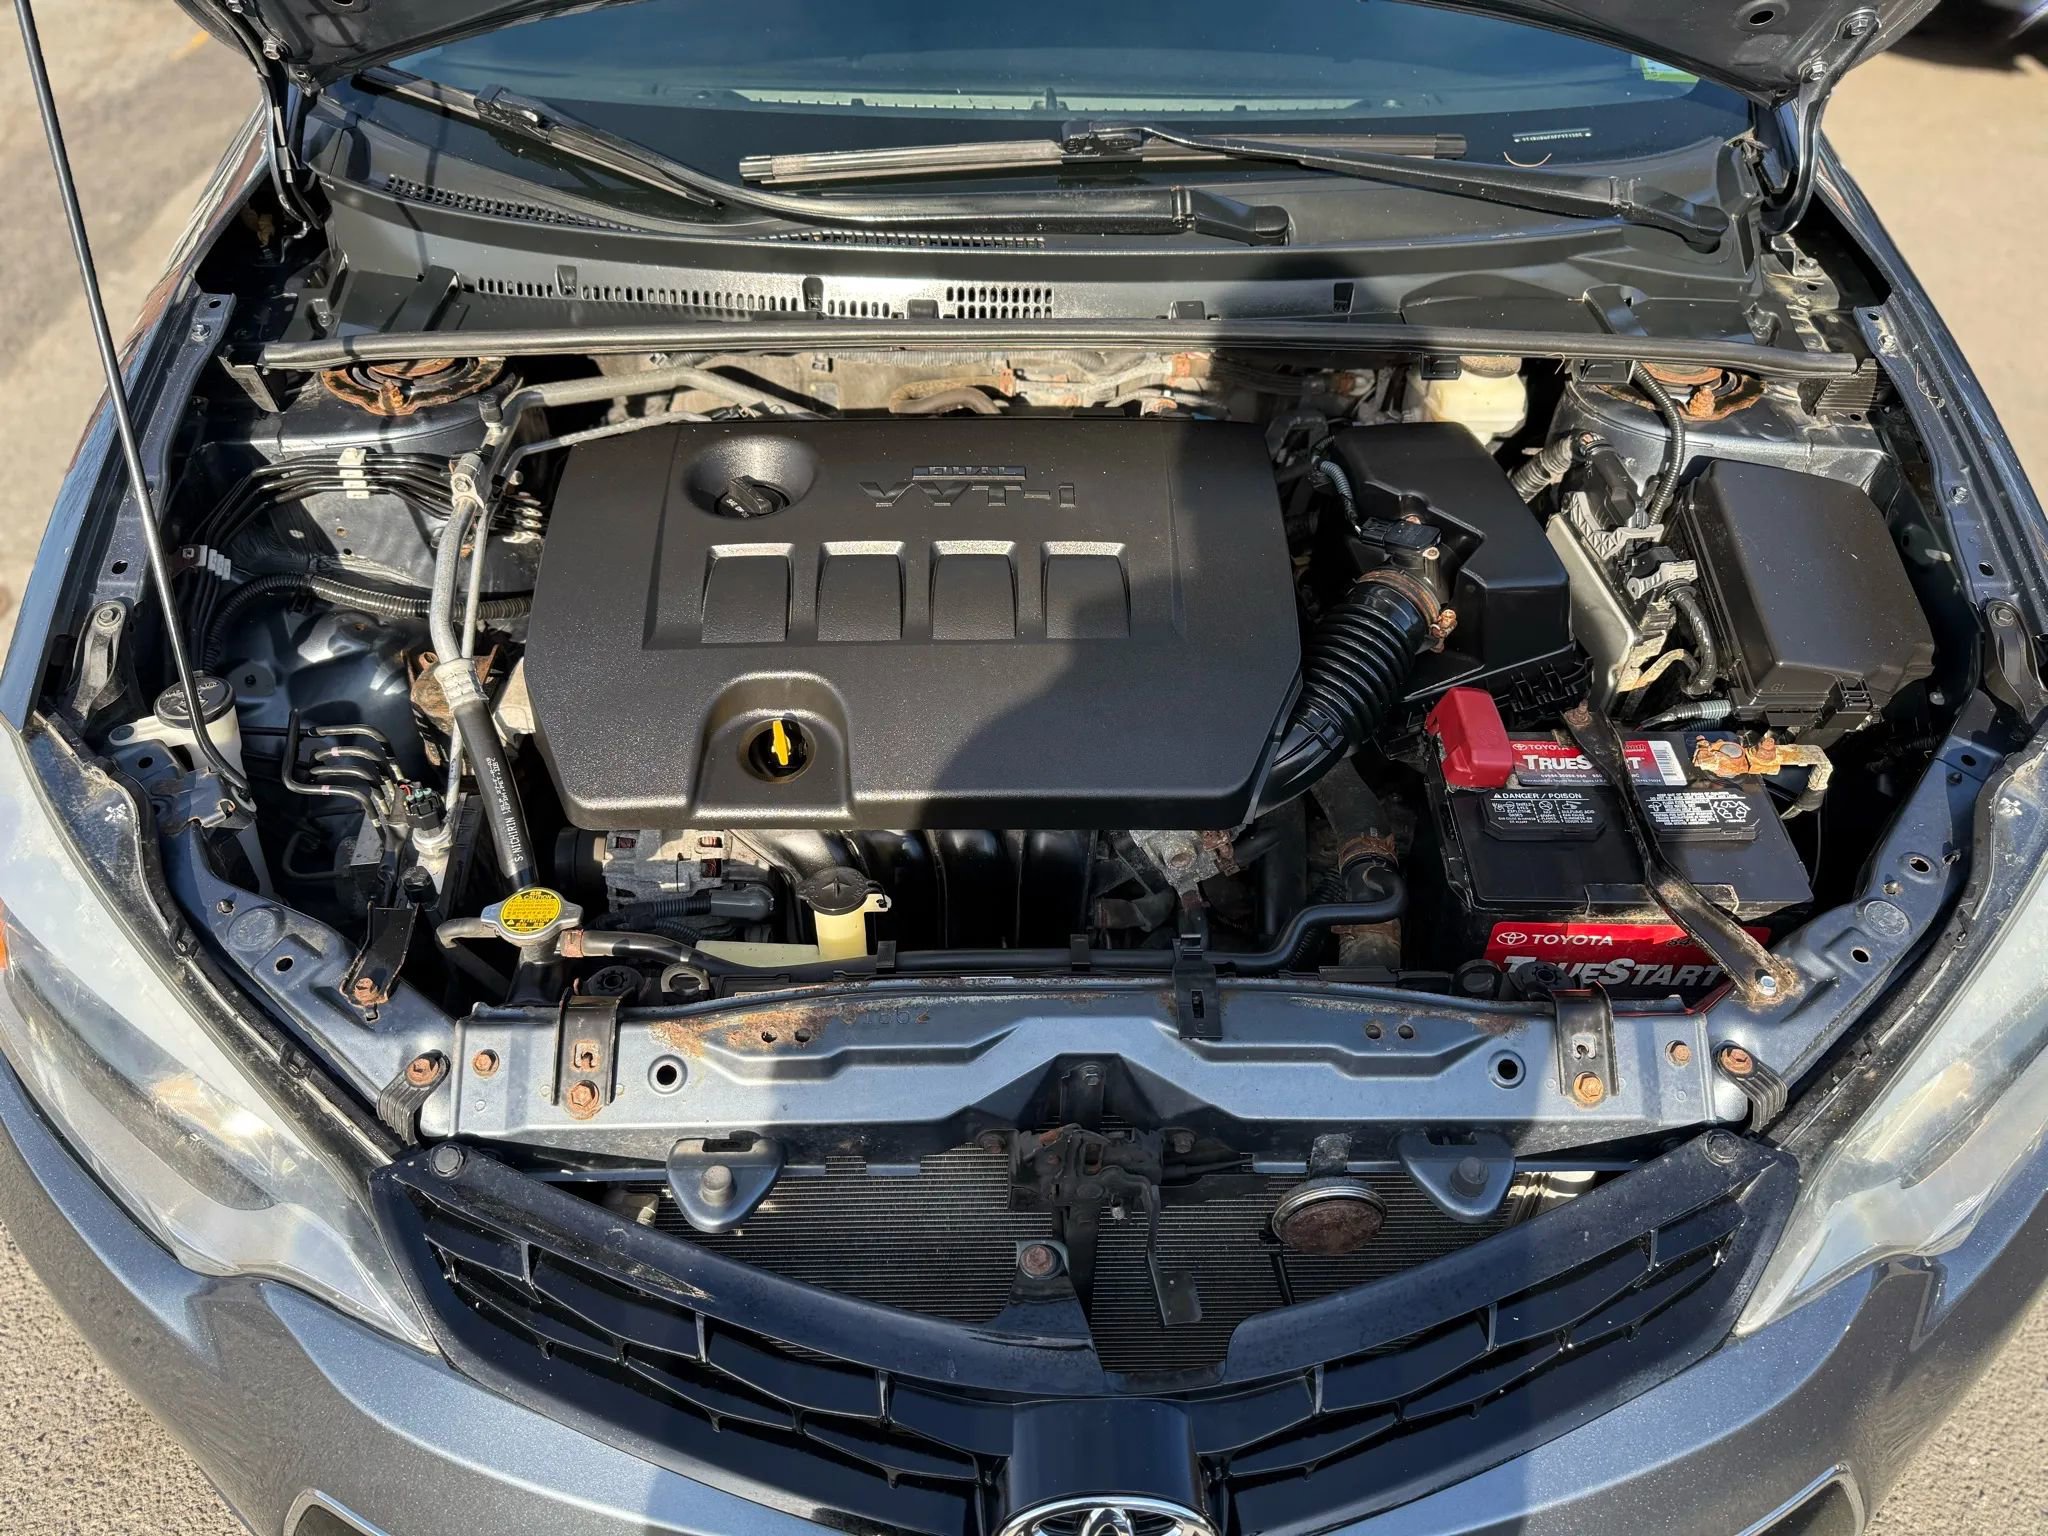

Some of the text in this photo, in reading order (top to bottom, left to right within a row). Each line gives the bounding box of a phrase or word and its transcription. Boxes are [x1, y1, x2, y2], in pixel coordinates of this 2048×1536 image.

[1522, 754, 1642, 771] TRUEST
[1531, 934, 1613, 946] TOYOTA
[1503, 956, 1722, 986] TUESTART
